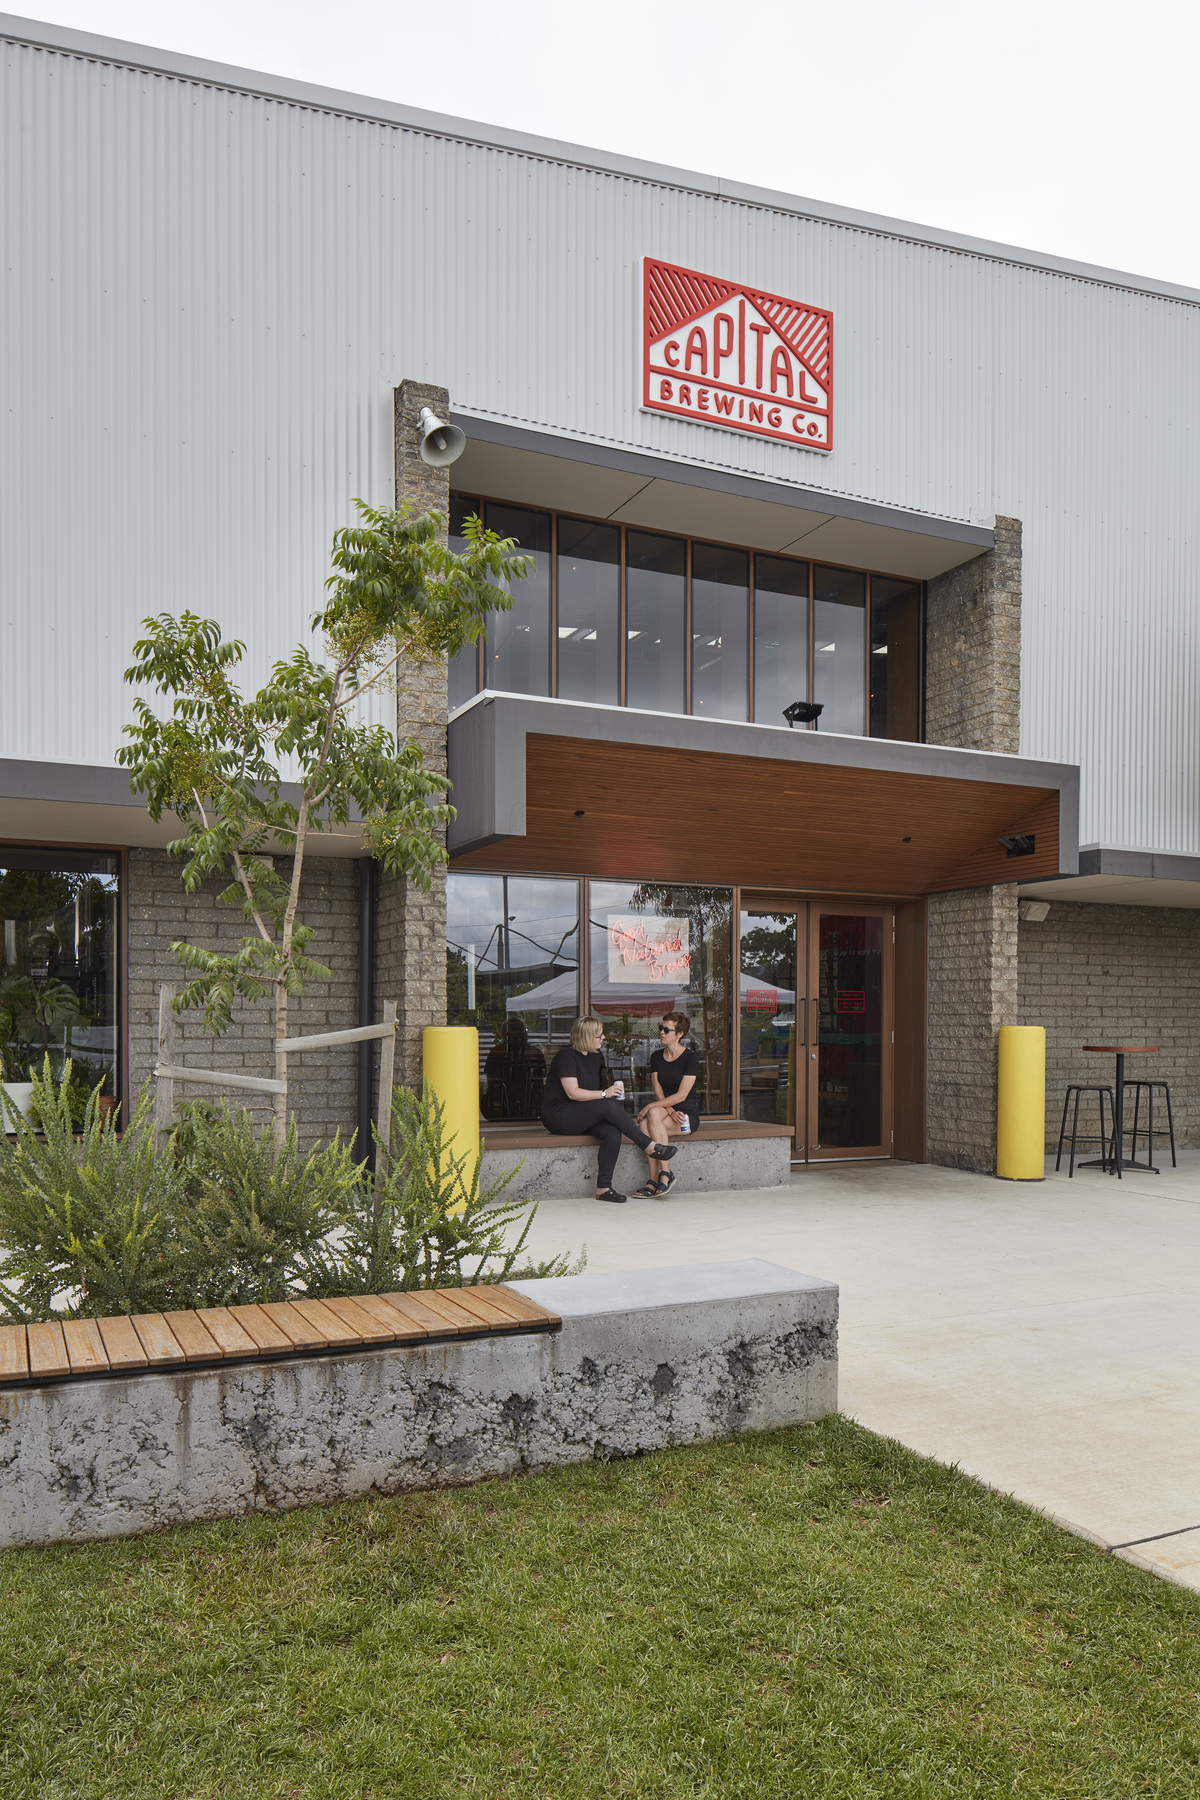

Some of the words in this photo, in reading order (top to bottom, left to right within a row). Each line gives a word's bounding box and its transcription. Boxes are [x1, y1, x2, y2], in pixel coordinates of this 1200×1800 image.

[664, 299, 818, 404] CAPITAL
[660, 379, 782, 428] BREWING
[792, 414, 823, 438] Co.
[612, 919, 645, 951] Good
[623, 928, 682, 967] Natured
[648, 954, 692, 981] Brews
